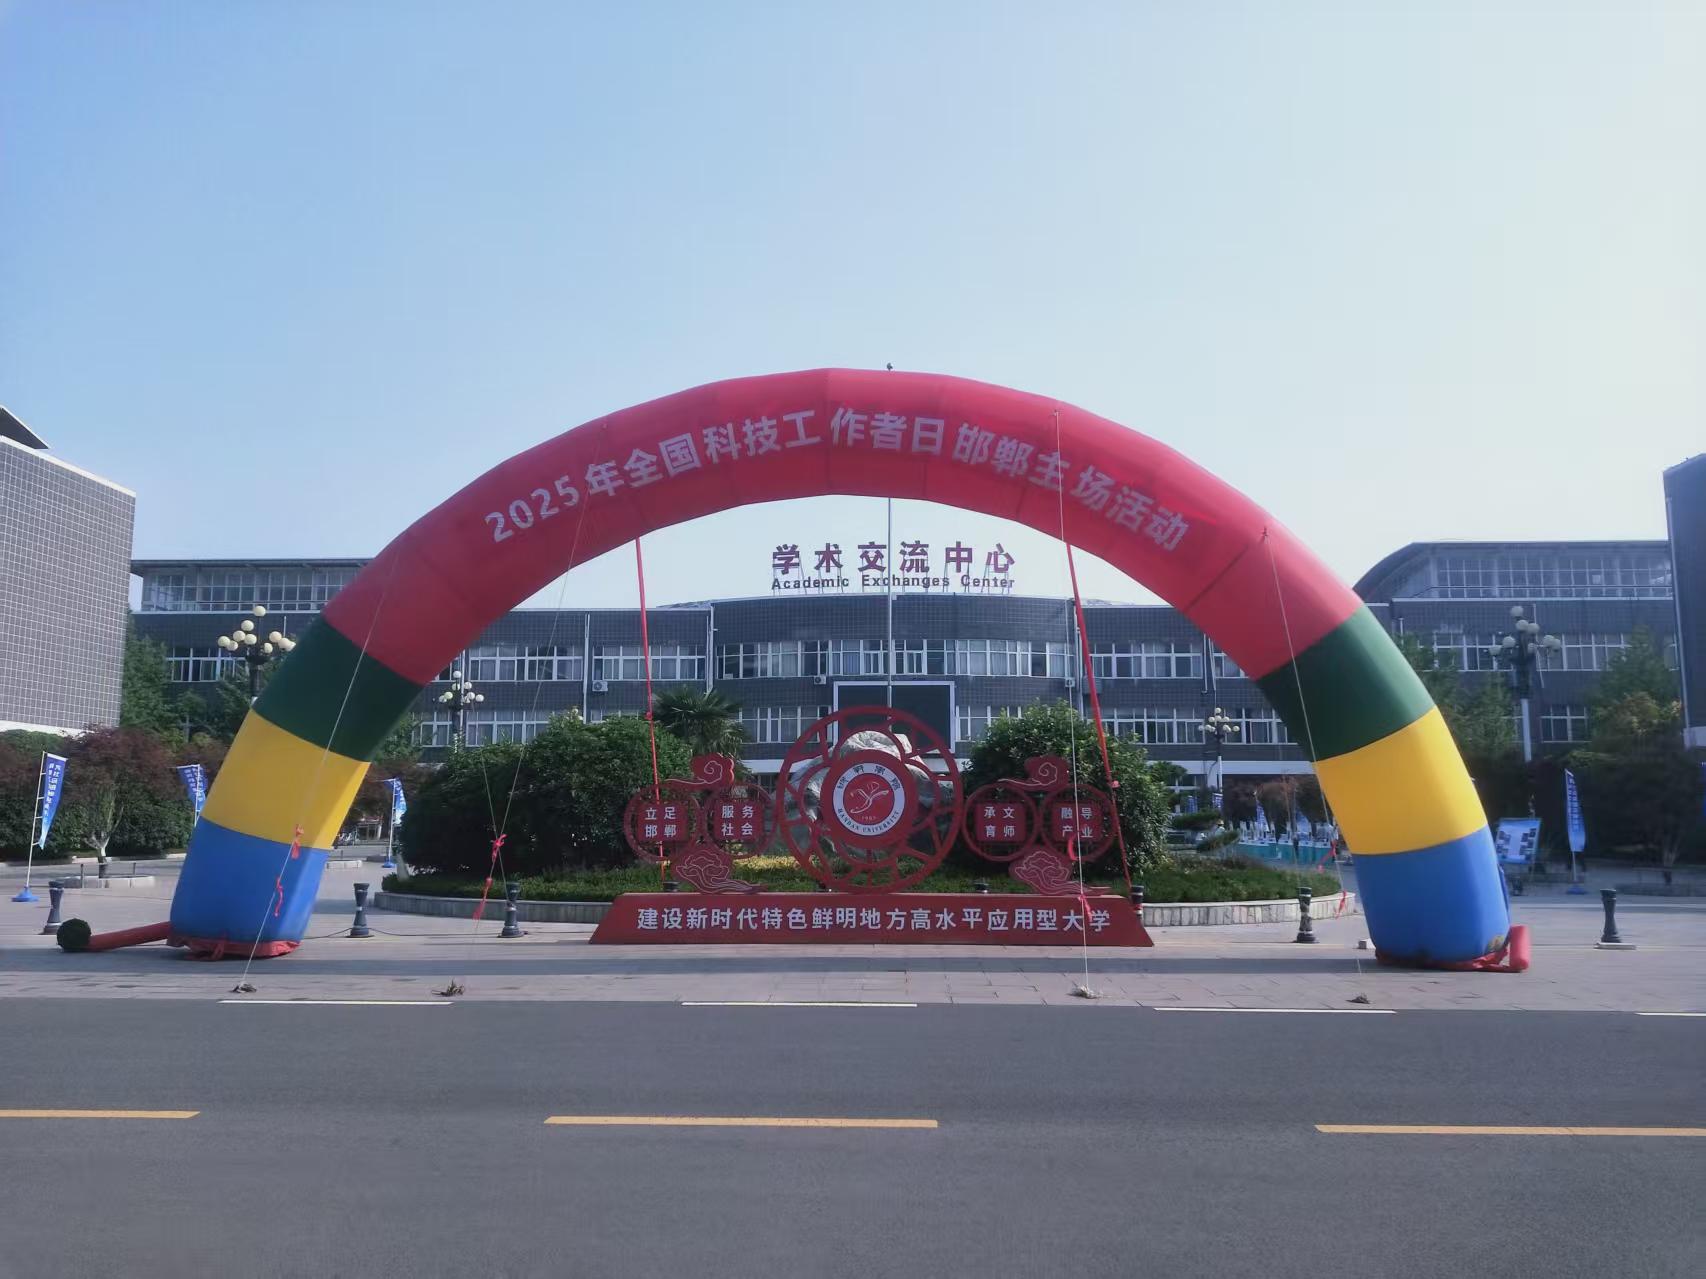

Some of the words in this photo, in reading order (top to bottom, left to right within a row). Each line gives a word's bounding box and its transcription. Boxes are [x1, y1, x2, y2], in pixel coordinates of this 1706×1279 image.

[485, 407, 1190, 552] 2025年全国科技工作者日邯郸主场活动
[772, 540, 1016, 575] 学术交流中心
[772, 576, 849, 590] Academic
[862, 574, 950, 589] Exchanges
[961, 575, 1016, 588] Center
[645, 807, 677, 821] 立足
[722, 805, 754, 819] 服务
[984, 806, 1016, 819] 承文
[1061, 807, 1093, 820] 融导
[837, 808, 859, 831] HANDAN
[863, 811, 900, 833] UNIVERSITY
[645, 824, 677, 838] 邯郸
[722, 823, 754, 837] 社会
[985, 825, 1016, 838] 育师
[1062, 825, 1094, 838] 产业
[637, 907, 1111, 931] 建设新时代特色鲜明地方高水平应用型大学
